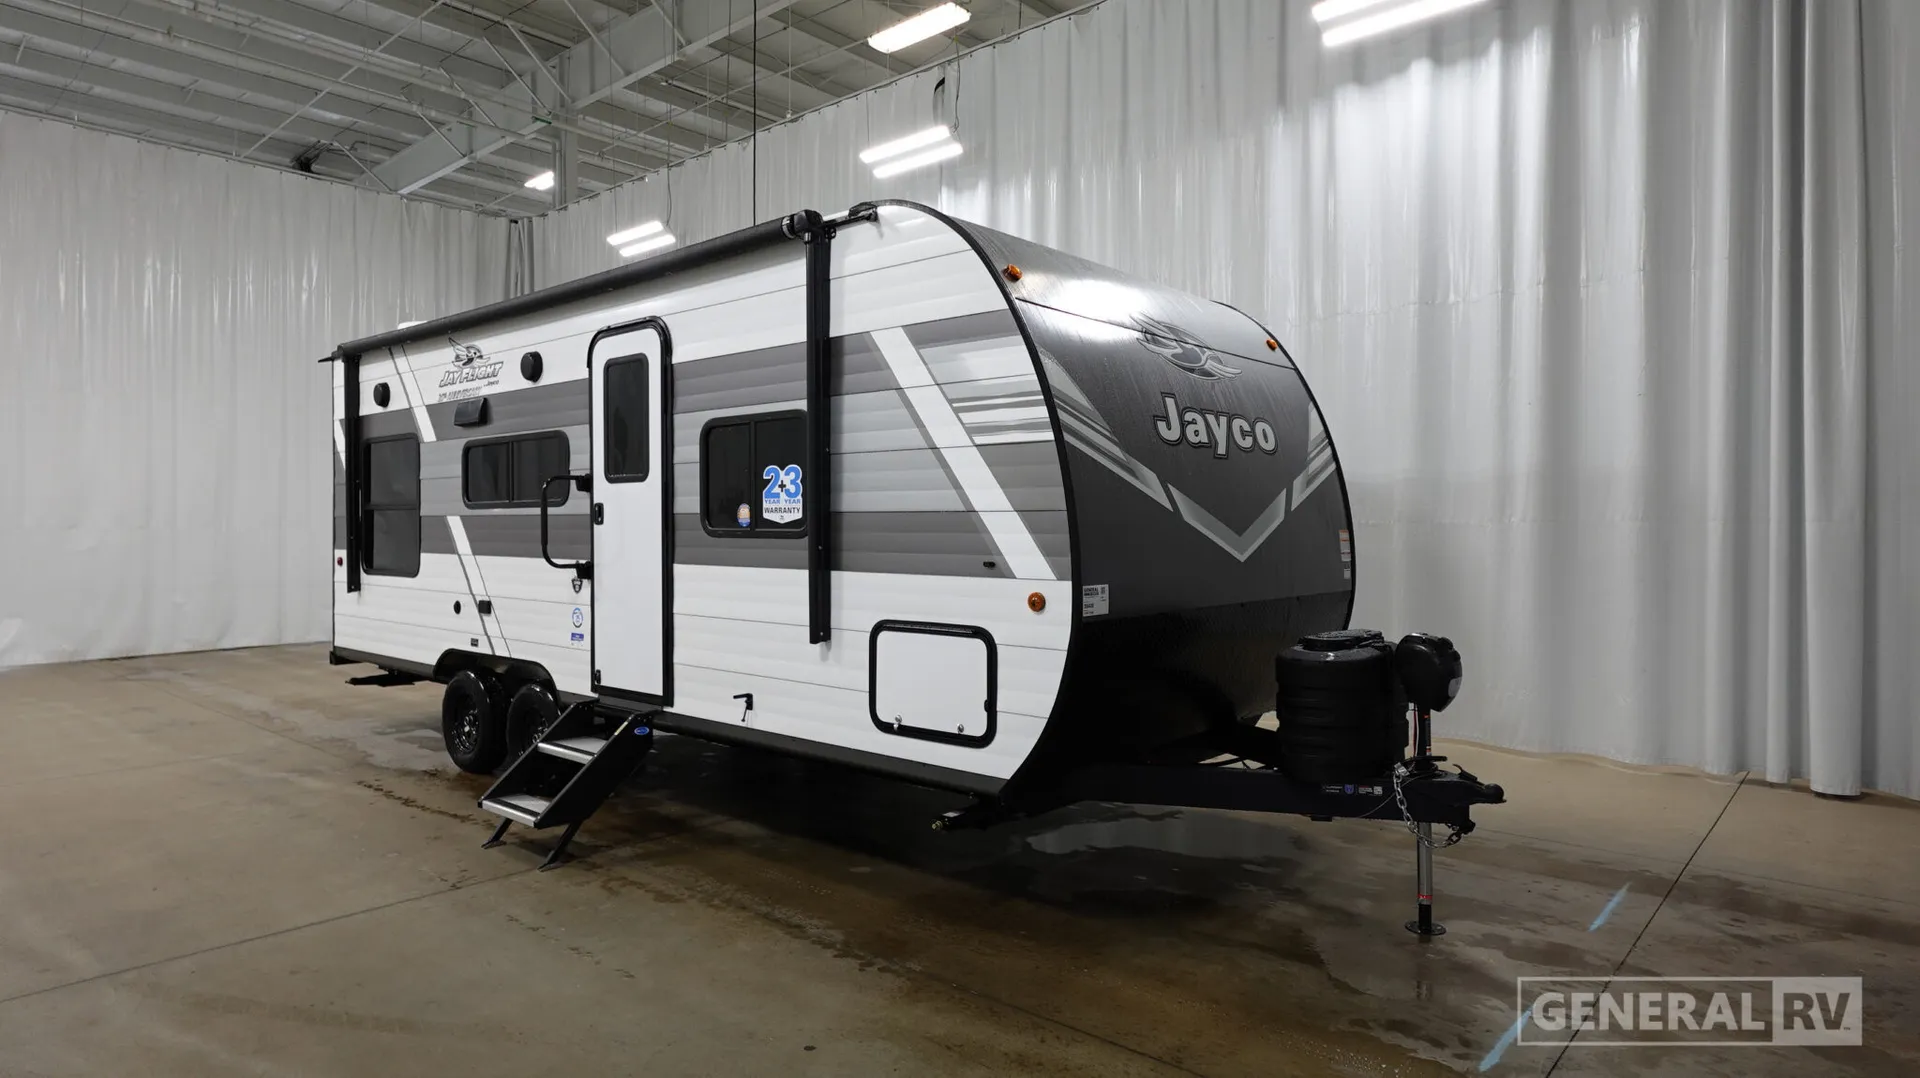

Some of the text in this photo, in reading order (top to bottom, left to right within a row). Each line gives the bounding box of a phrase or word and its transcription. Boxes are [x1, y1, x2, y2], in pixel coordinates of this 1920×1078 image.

[438, 361, 503, 388] JAY FLIGHT
[1153, 391, 1278, 459] Jayco
